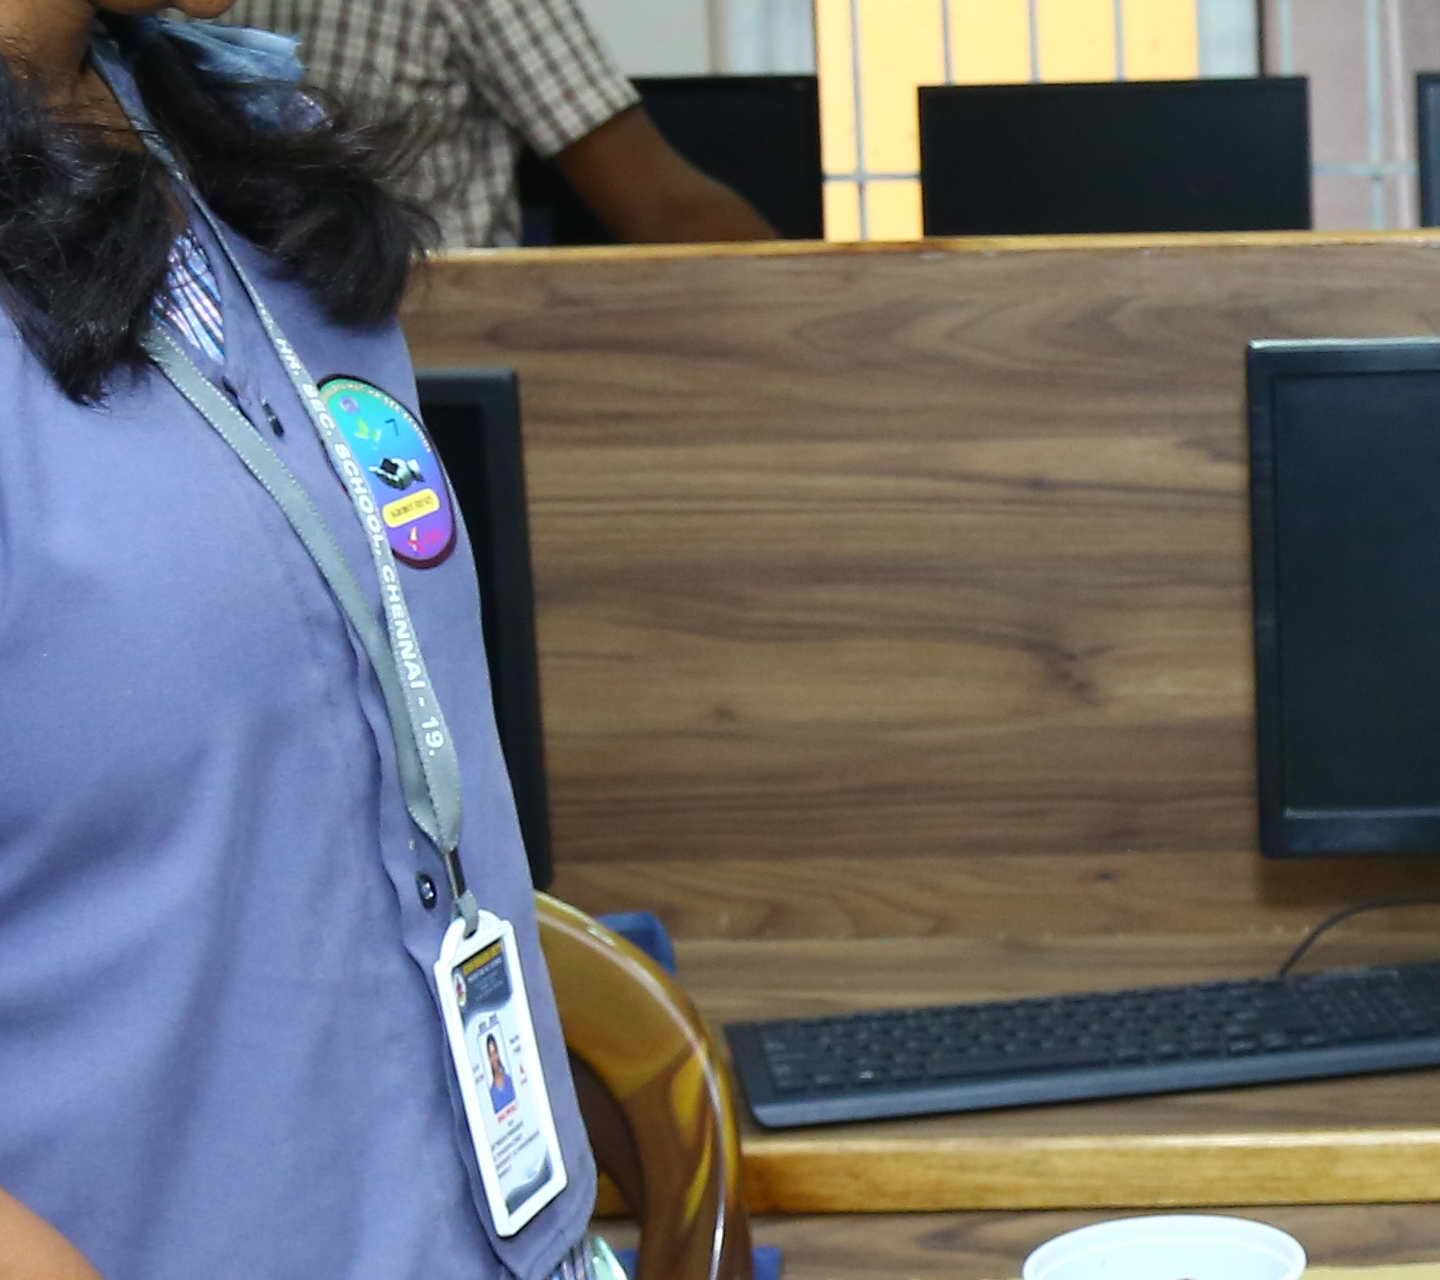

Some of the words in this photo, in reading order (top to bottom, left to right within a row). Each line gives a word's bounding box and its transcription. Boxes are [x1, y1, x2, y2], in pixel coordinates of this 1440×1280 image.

[334, 442, 383, 556] SCHOOL,
[382, 564, 427, 689] CHENNAI
[420, 715, 445, 757] 19.
